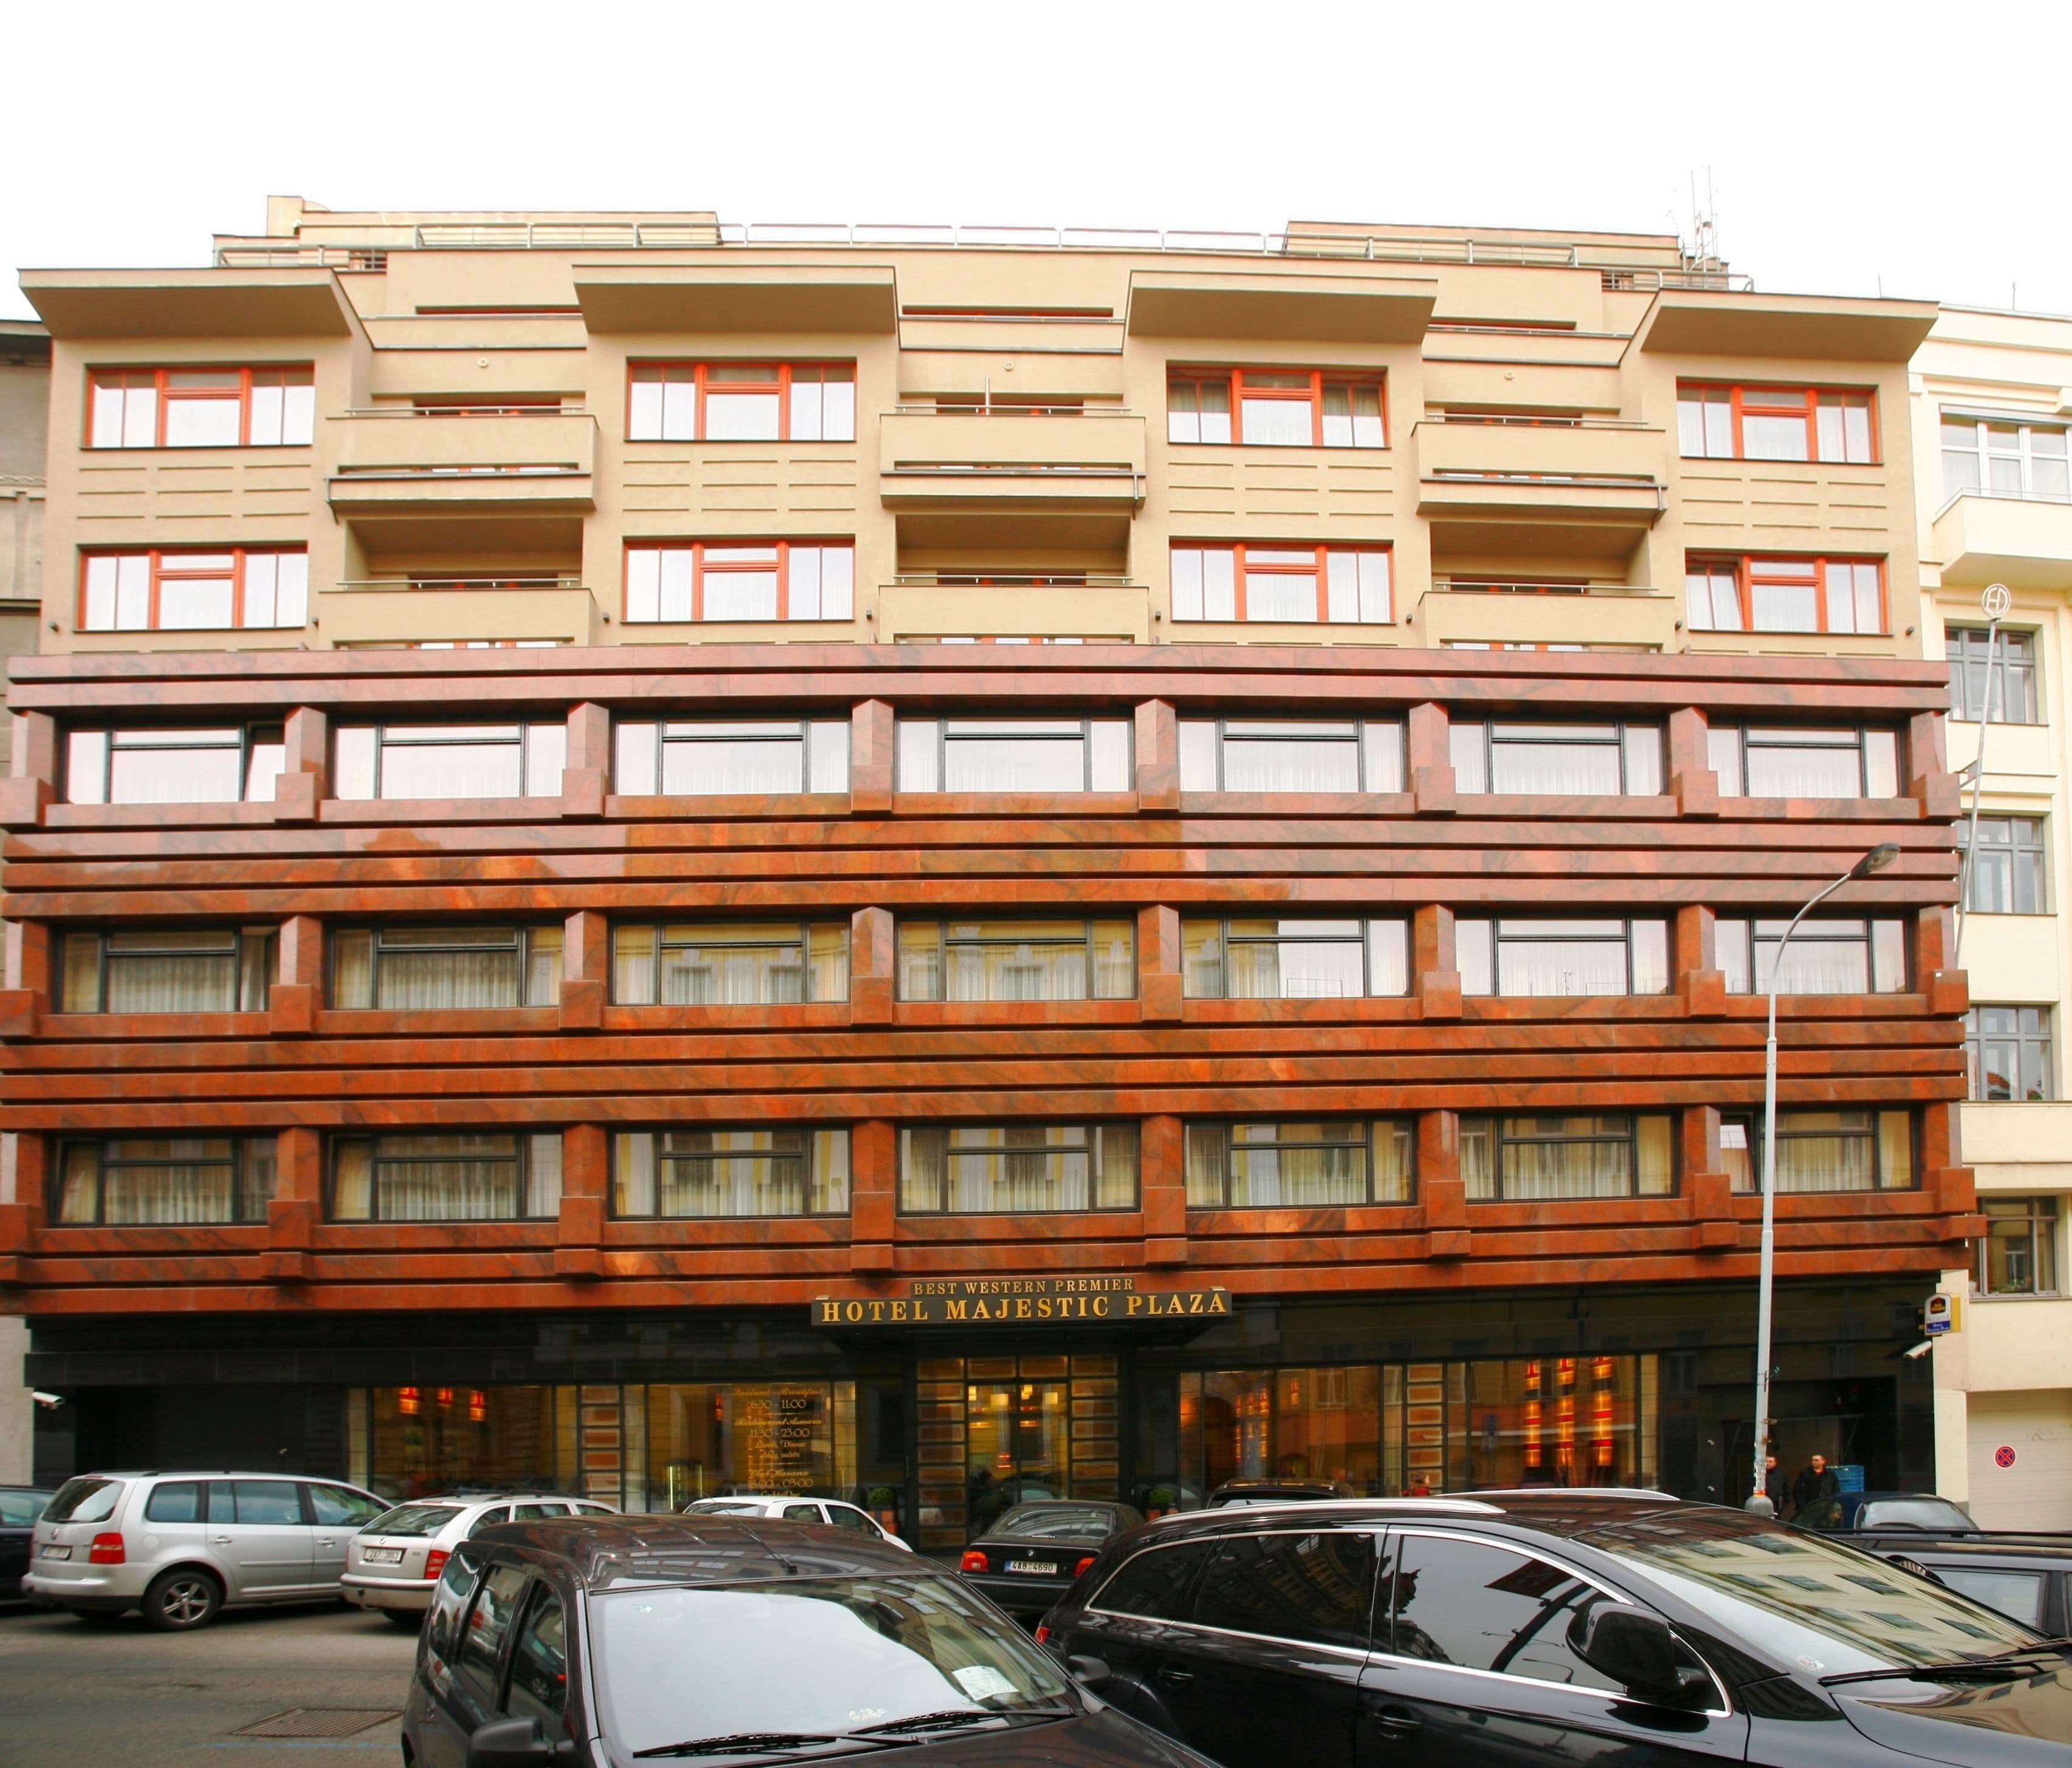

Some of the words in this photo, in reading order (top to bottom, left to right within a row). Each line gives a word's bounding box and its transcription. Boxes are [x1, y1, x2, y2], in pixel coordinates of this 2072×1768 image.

[914, 1282, 956, 1295] BEST
[965, 1280, 1046, 1294] WESTERN
[1055, 1279, 1133, 1292] PREMIER
[822, 1301, 928, 1322] HOTEL
[946, 1296, 1108, 1319] MAJESTIC
[1126, 1293, 1226, 1315] PLAZA
[751, 1399, 772, 1409] 6:30
[782, 1399, 806, 1409] 11:00
[781, 1428, 809, 1437] 23:00
[770, 1469, 808, 1478] Havana
[1033, 1562, 1053, 1571] 4690
